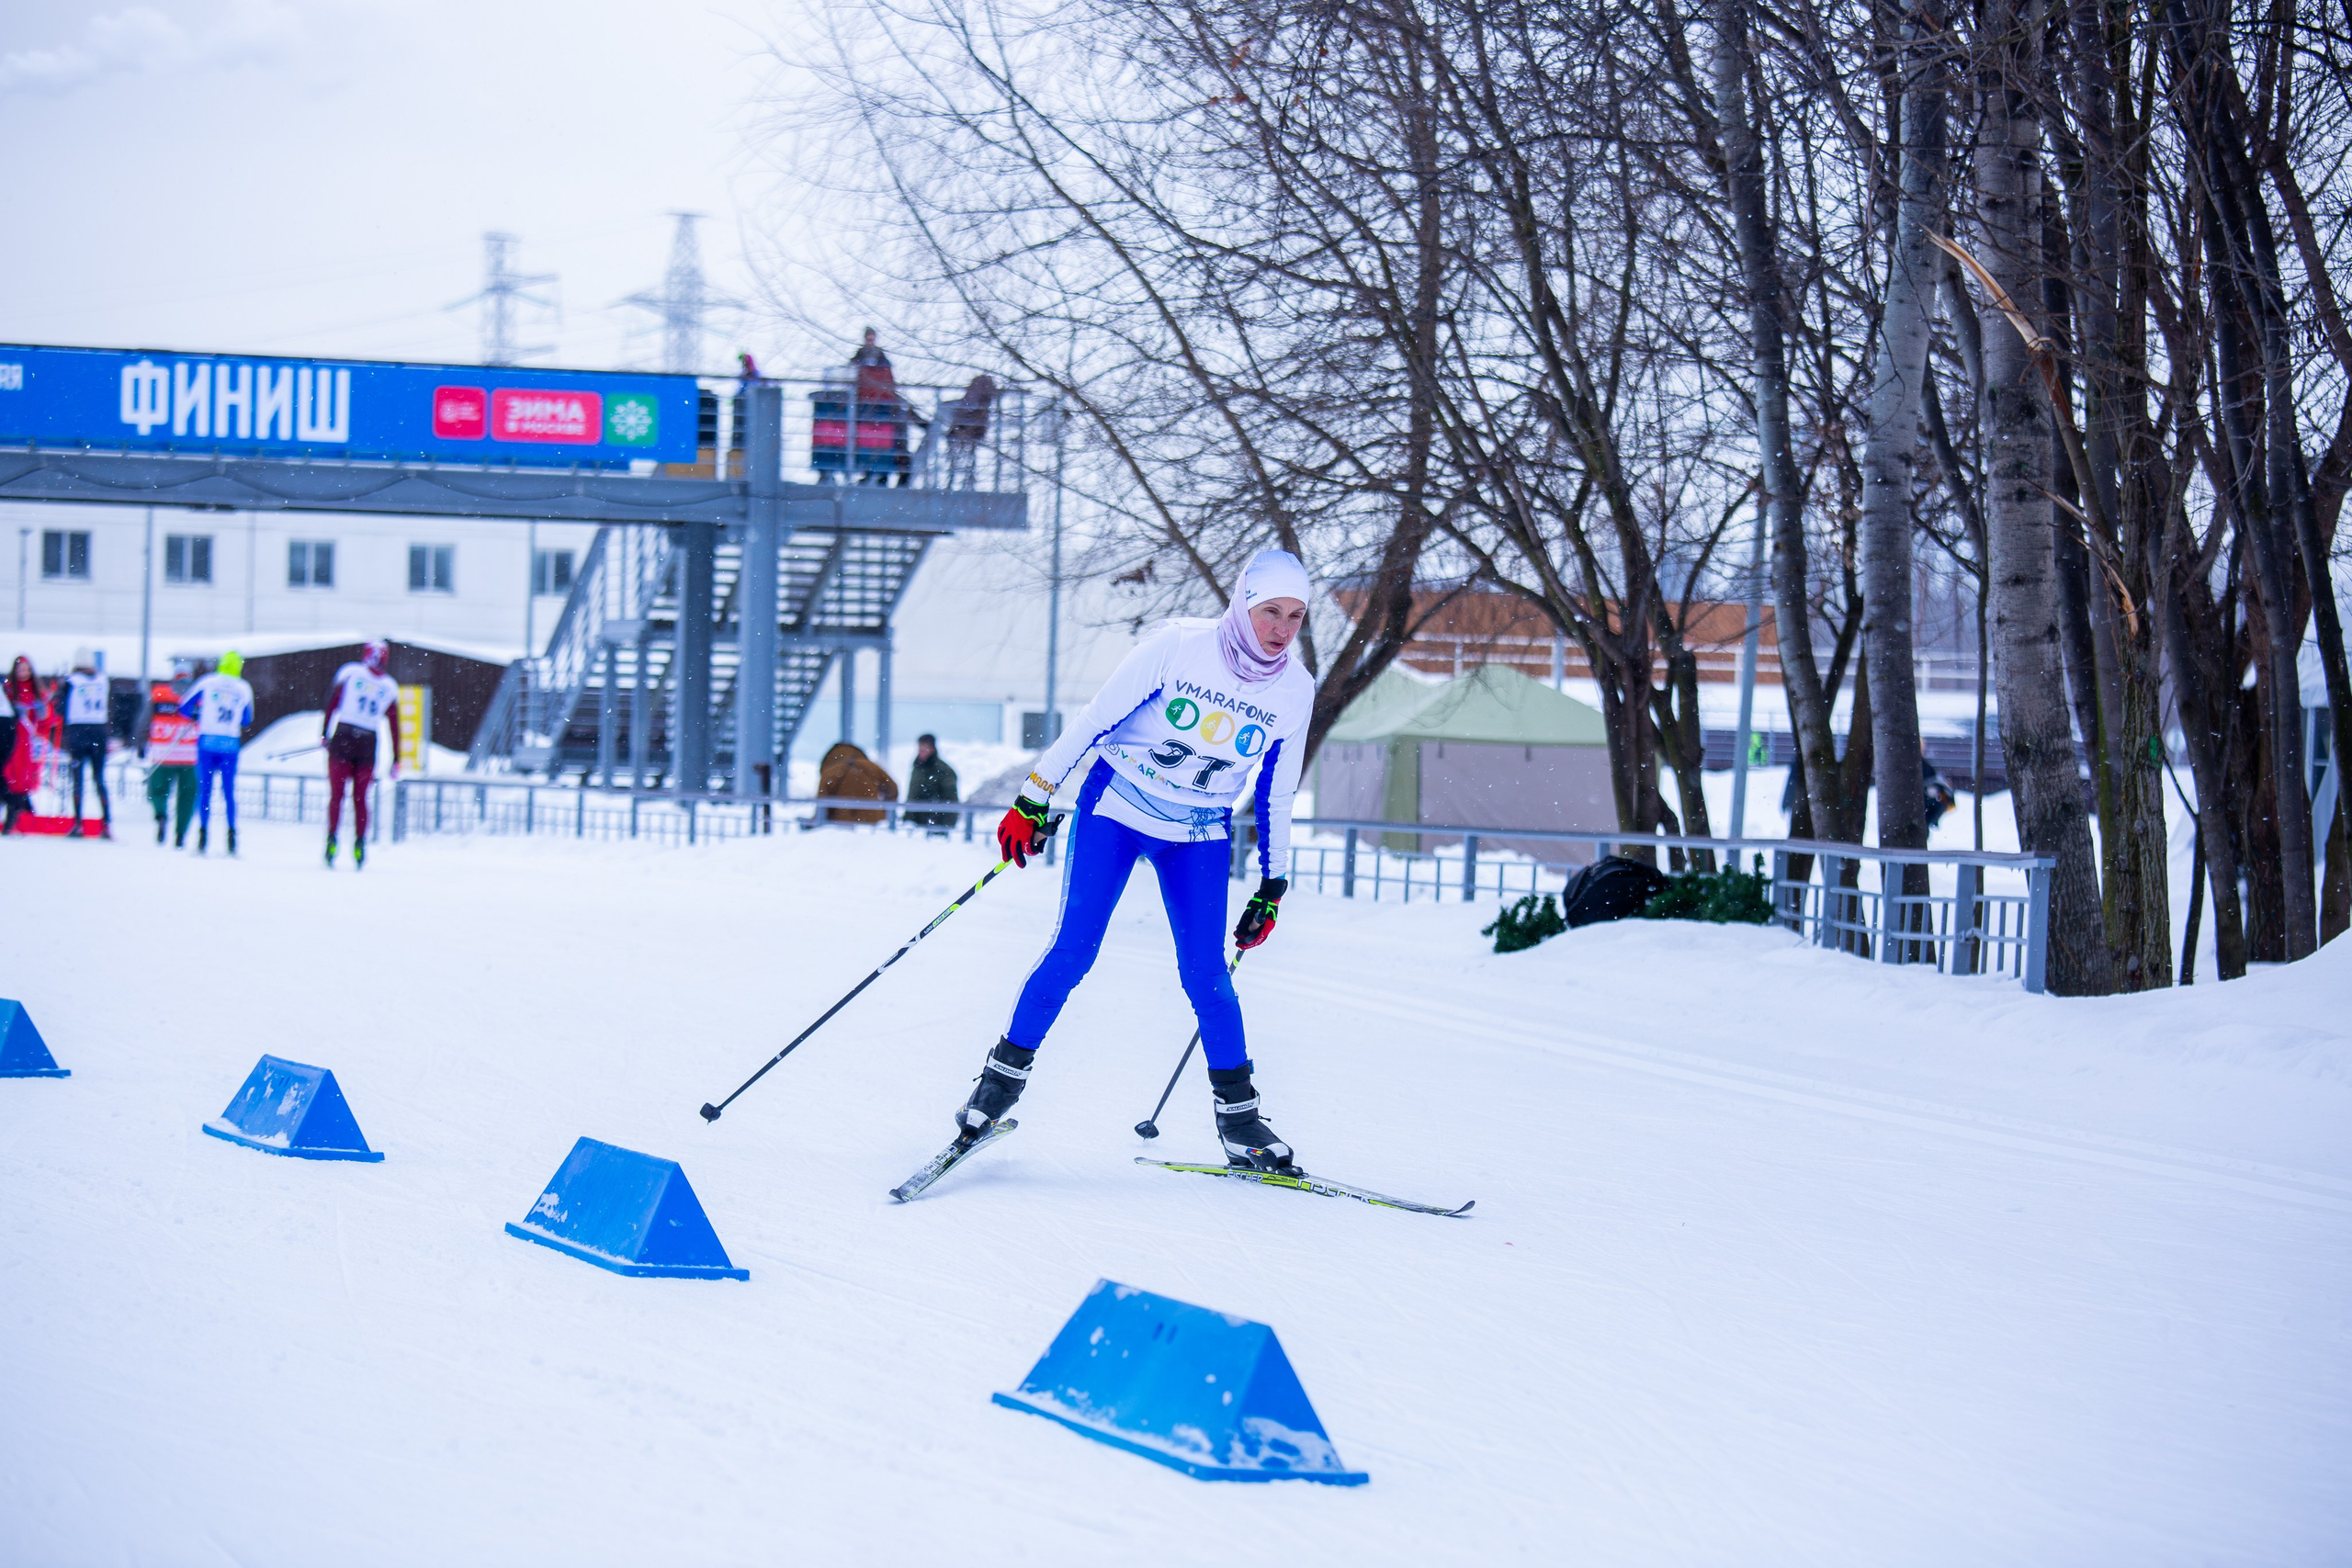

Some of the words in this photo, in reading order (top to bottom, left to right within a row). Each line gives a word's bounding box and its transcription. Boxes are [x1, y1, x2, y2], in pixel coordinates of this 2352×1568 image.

[120, 358, 351, 444] ФИНИШ
[507, 396, 586, 423] ЗИМА
[1176, 680, 1278, 728] VMARAFONE
